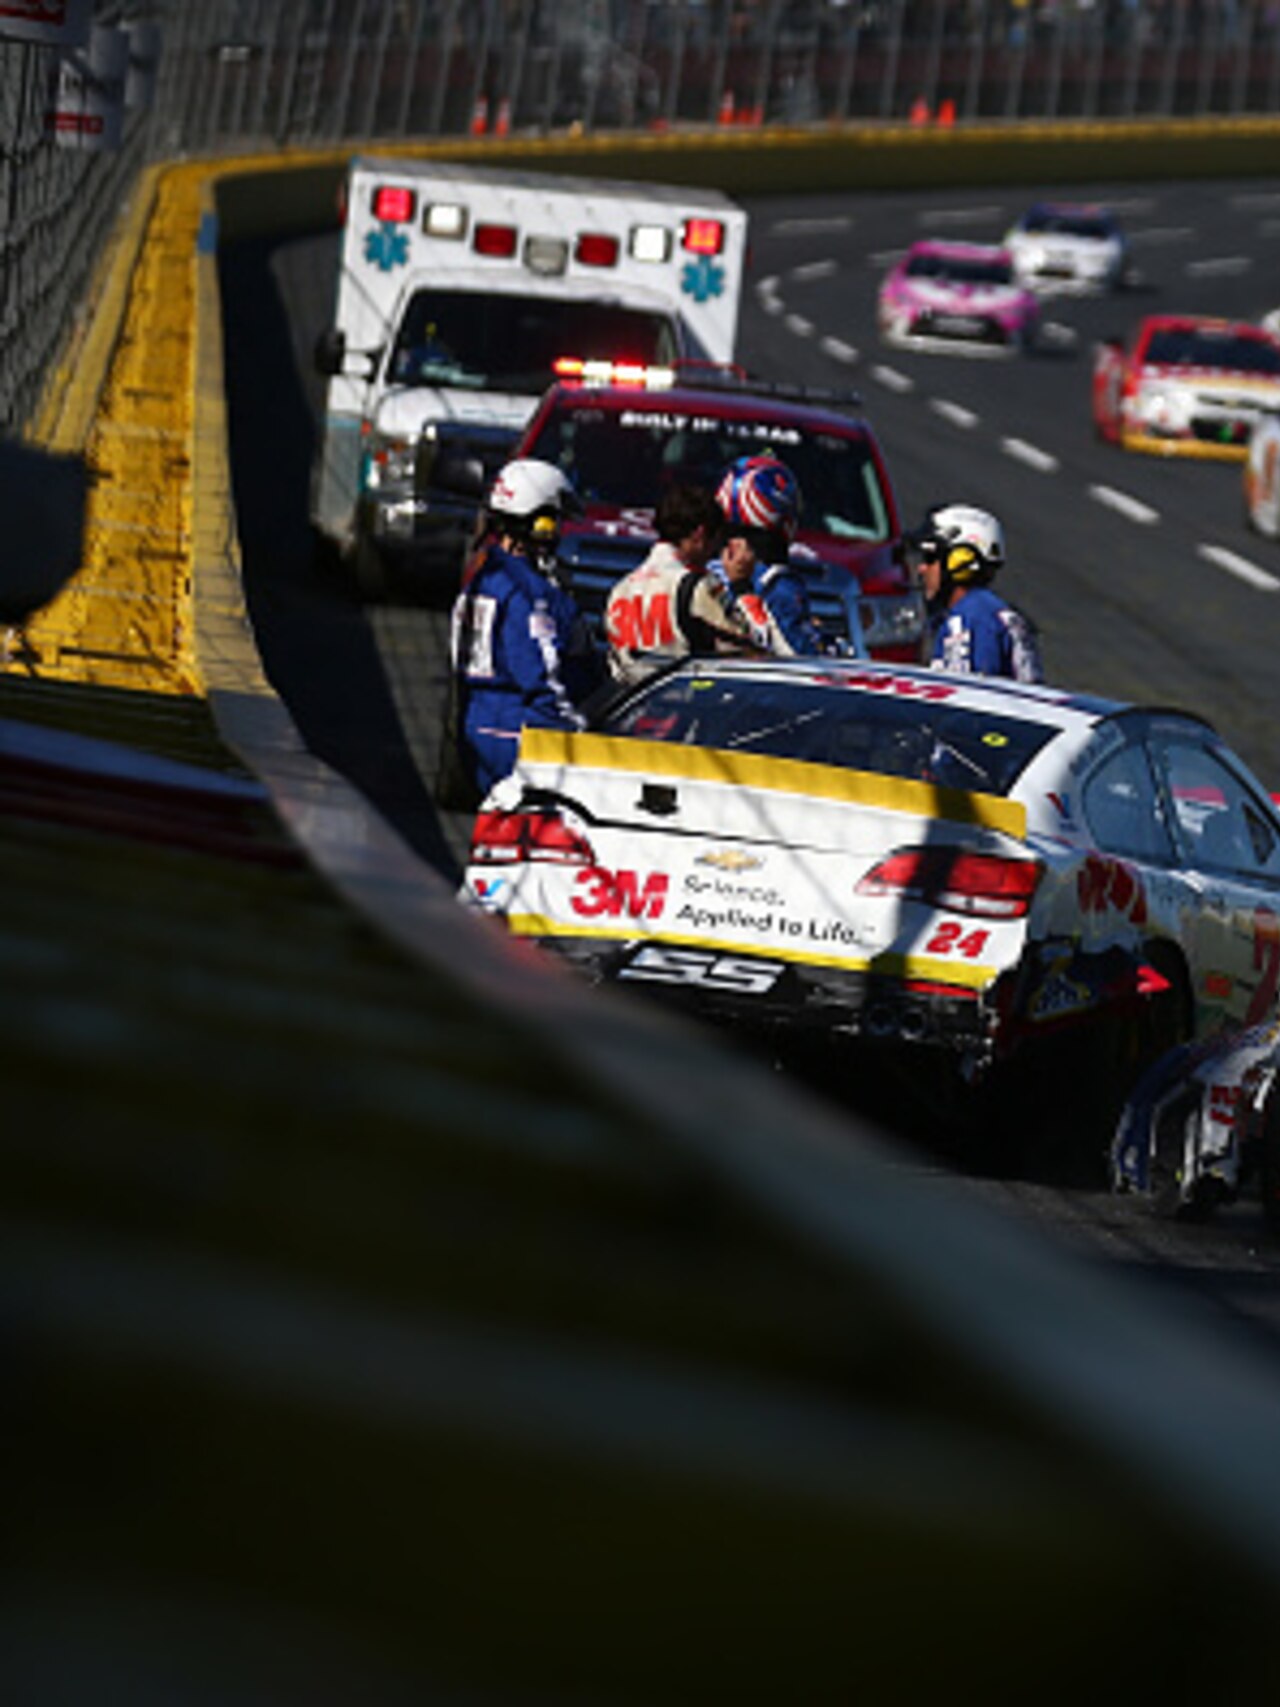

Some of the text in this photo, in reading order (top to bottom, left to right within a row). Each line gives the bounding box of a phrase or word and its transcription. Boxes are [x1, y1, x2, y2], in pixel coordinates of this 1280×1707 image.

[606, 593, 675, 652] 3M
[570, 865, 670, 920] 3M
[675, 904, 773, 933] Applied
[778, 917, 802, 936] to
[925, 921, 991, 958] 24
[617, 948, 787, 993] SS
